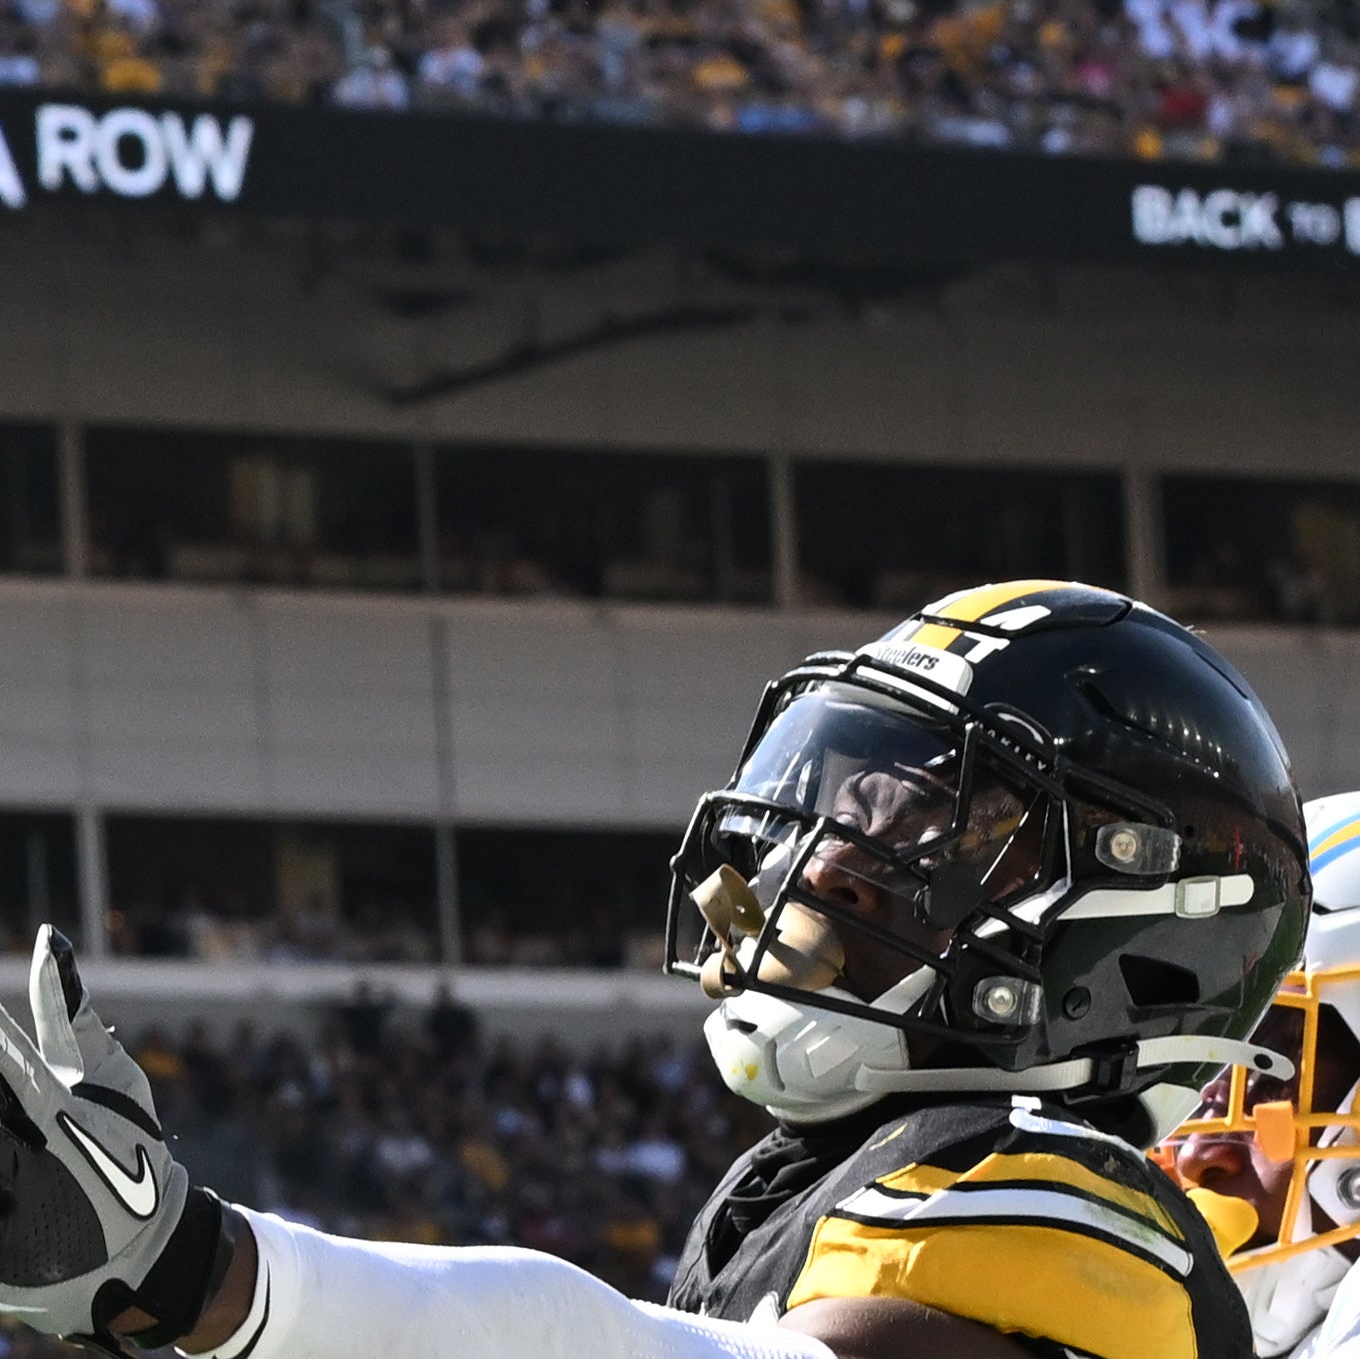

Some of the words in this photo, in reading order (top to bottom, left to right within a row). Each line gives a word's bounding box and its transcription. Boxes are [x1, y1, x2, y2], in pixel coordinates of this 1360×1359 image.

[36, 104, 253, 200] ROW
[1132, 185, 1281, 249] BACK
[1290, 203, 1340, 243] TO
